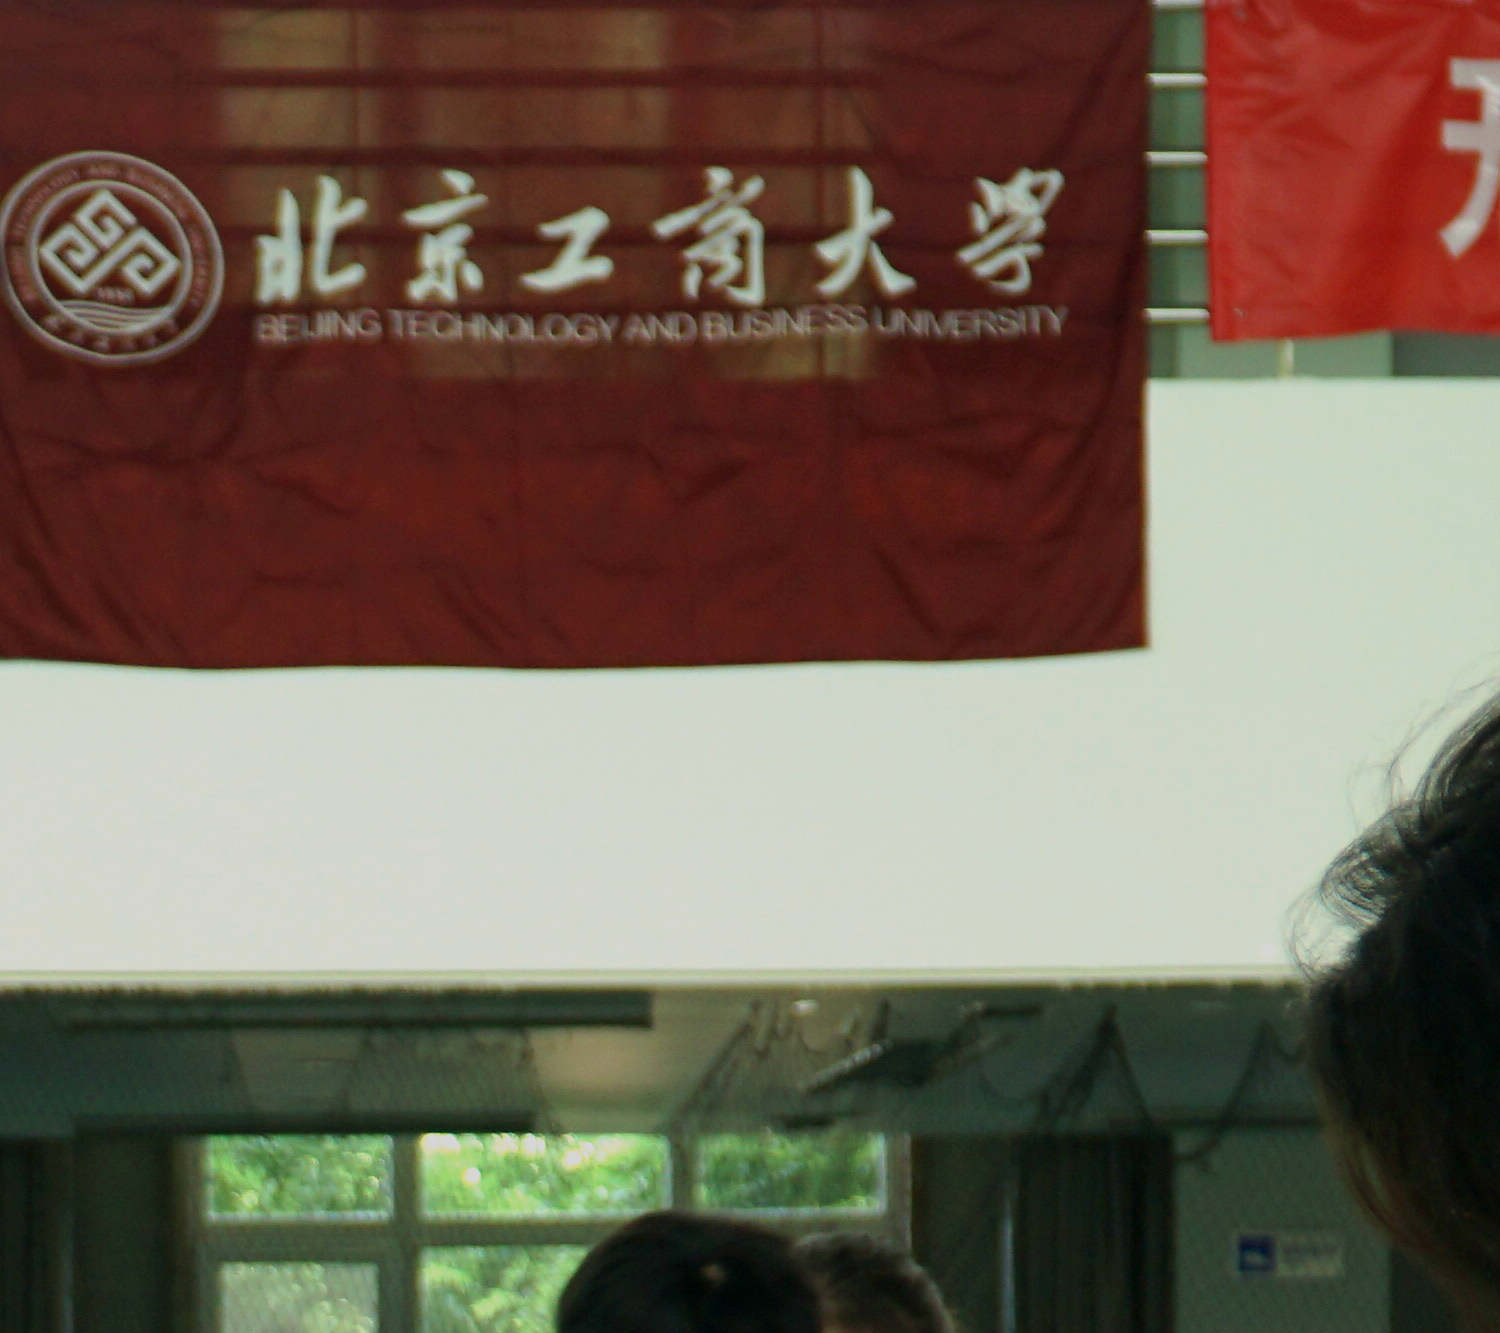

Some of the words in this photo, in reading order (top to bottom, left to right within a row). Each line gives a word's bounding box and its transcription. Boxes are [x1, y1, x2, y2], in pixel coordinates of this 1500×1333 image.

[255, 308, 382, 344] BEIJING
[386, 309, 619, 344] TECHNOLOGY
[622, 310, 698, 343] AND
[701, 304, 867, 342] BUSINESS
[873, 304, 1069, 340] UNIVERSITY
